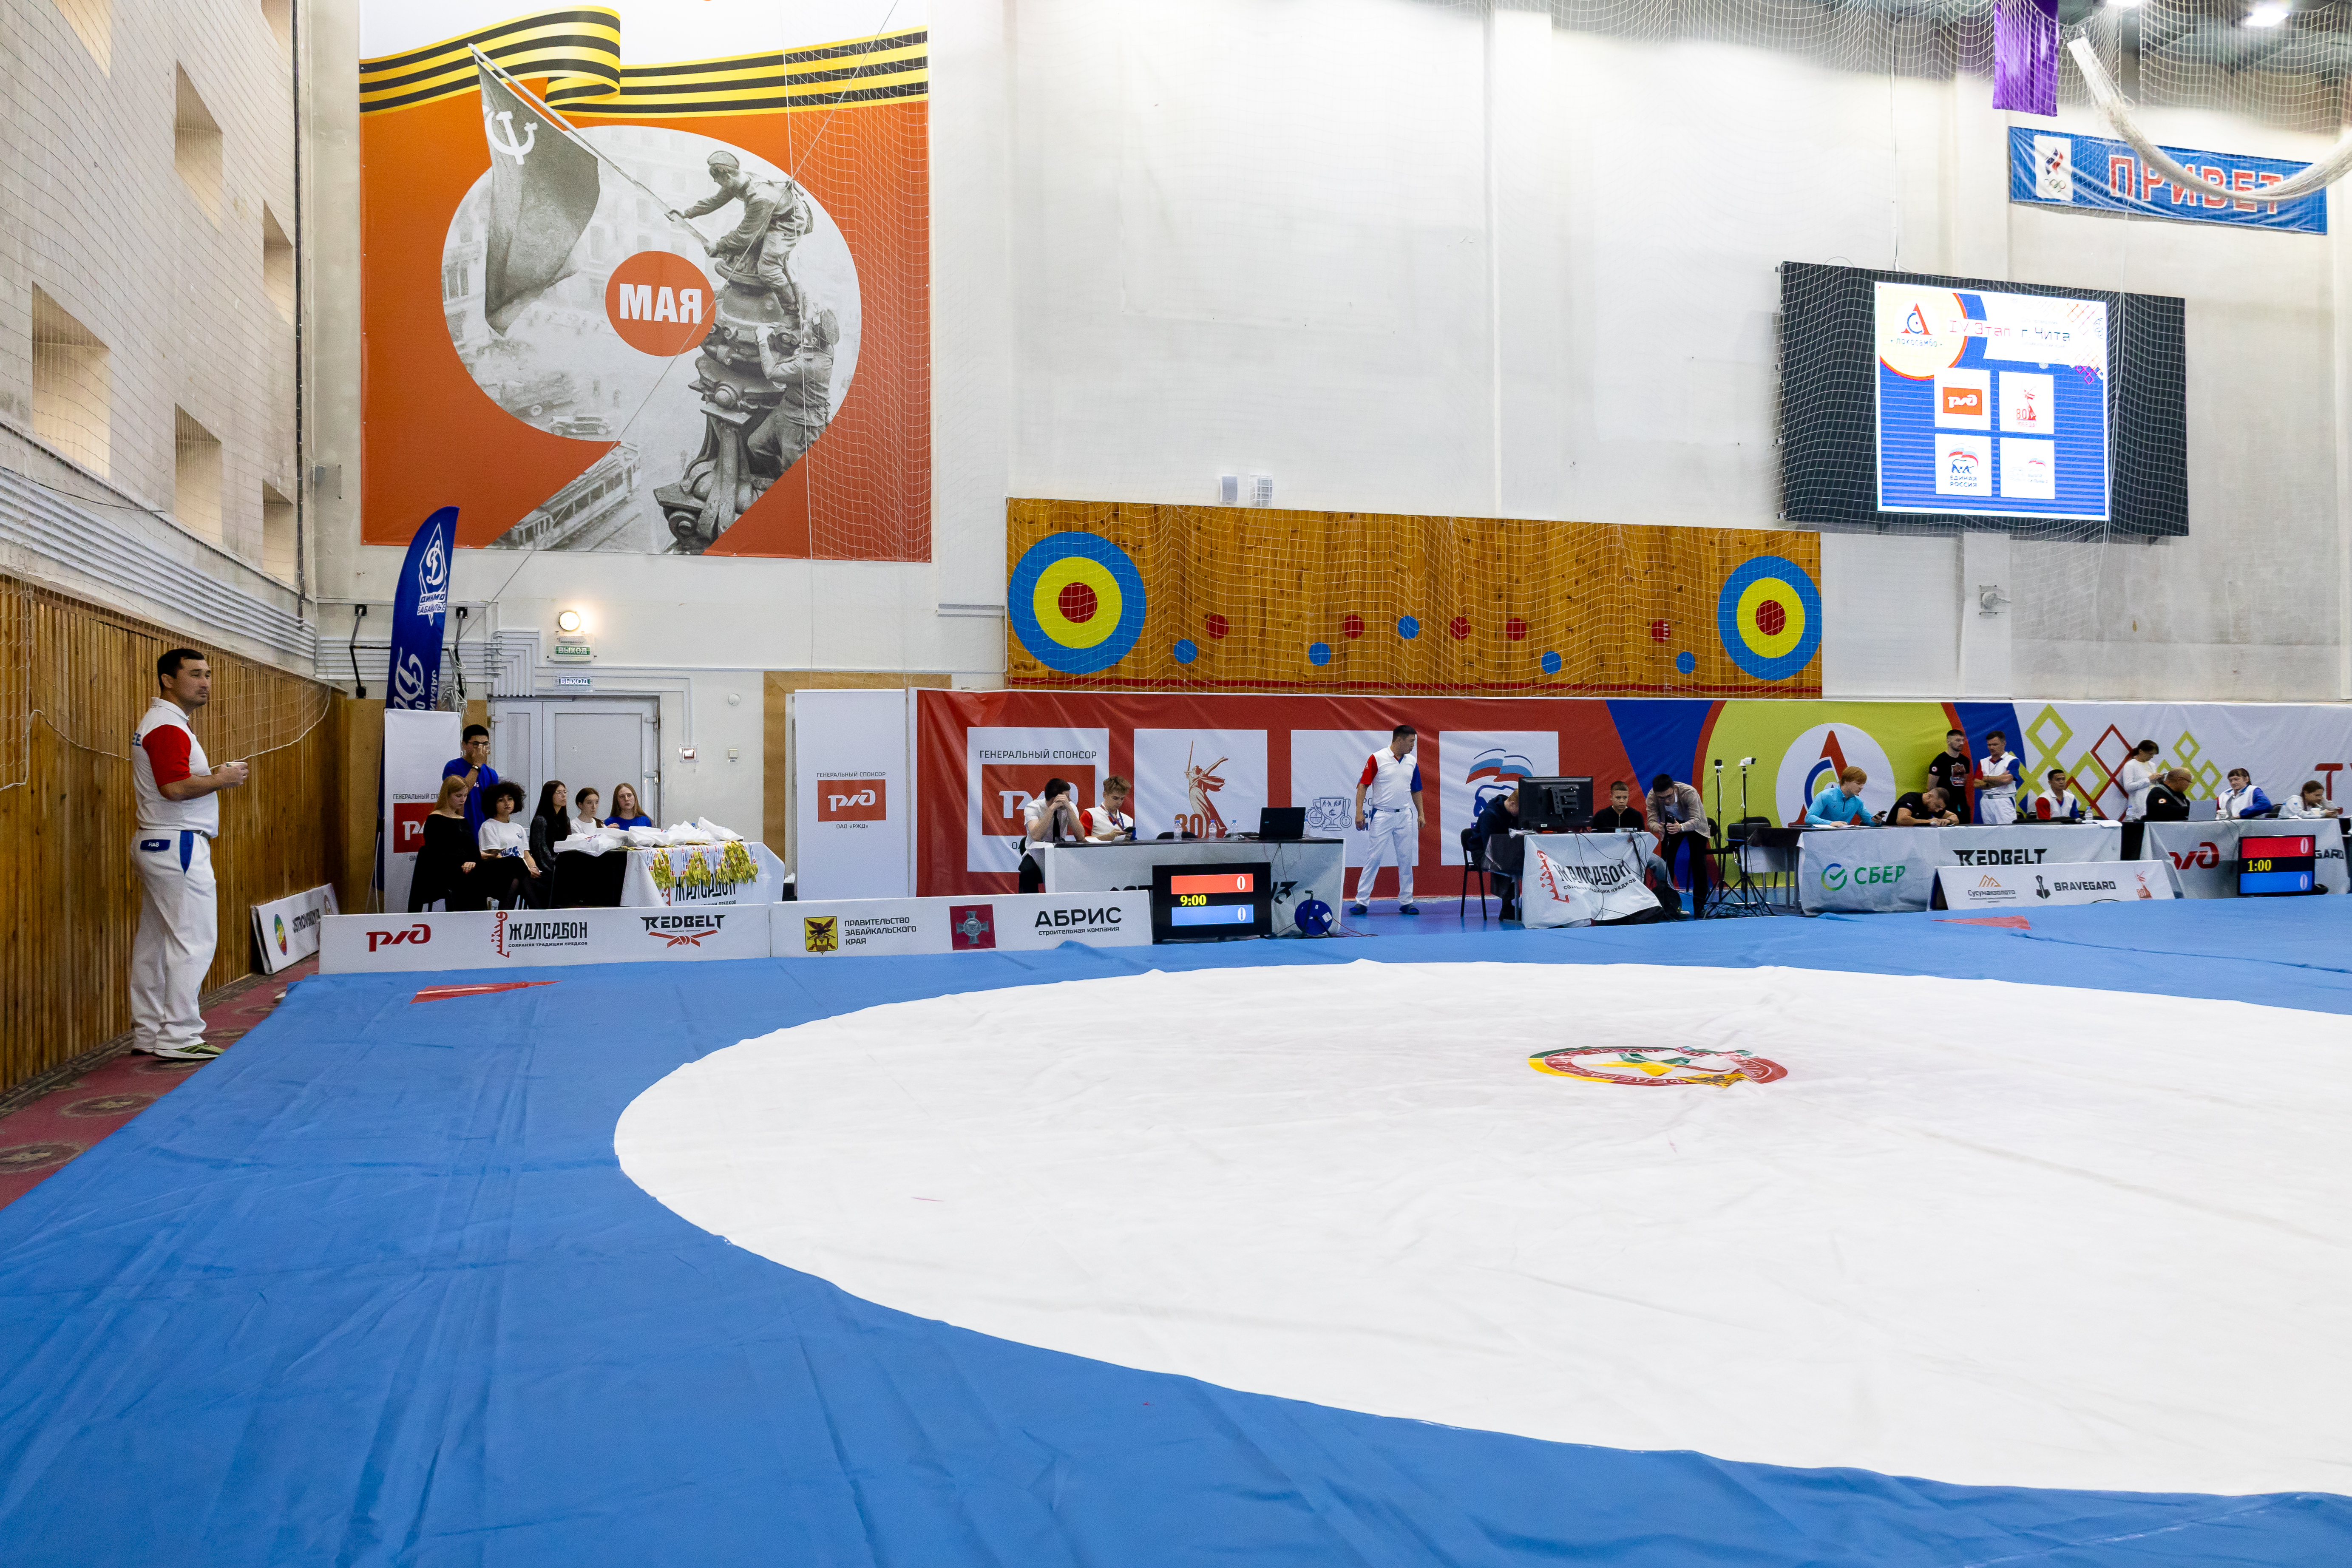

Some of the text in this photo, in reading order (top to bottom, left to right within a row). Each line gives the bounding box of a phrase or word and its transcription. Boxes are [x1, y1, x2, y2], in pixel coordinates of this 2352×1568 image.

[2108, 154, 2283, 215] ПРИВЕТ
[620, 283, 702, 324] МАЯ
[2035, 327, 2070, 341] Чита
[980, 749, 1097, 759] ГЕНЕРАЛЬНЫЙ СПОНСОР
[2300, 838, 2309, 854] 0
[1952, 848, 2047, 866] REDBELT
[2247, 859, 2271, 871] 1:00
[1854, 865, 1905, 885] СБЕР
[2300, 873, 2308, 890] 0
[1237, 876, 1246, 890] 0
[2054, 881, 2116, 891] BRAVEGARD
[1180, 895, 1206, 906] 9:00
[1034, 907, 1122, 928] АБРИС
[1237, 907, 1246, 921] 0
[640, 915, 726, 932] REDBELT
[845, 917, 910, 927] ПРАВИТЕЛЬСТВО
[509, 922, 587, 940] ЖАЛСАБОН
[845, 925, 916, 936] ЗАБАЙКАЛЬСКОГО
